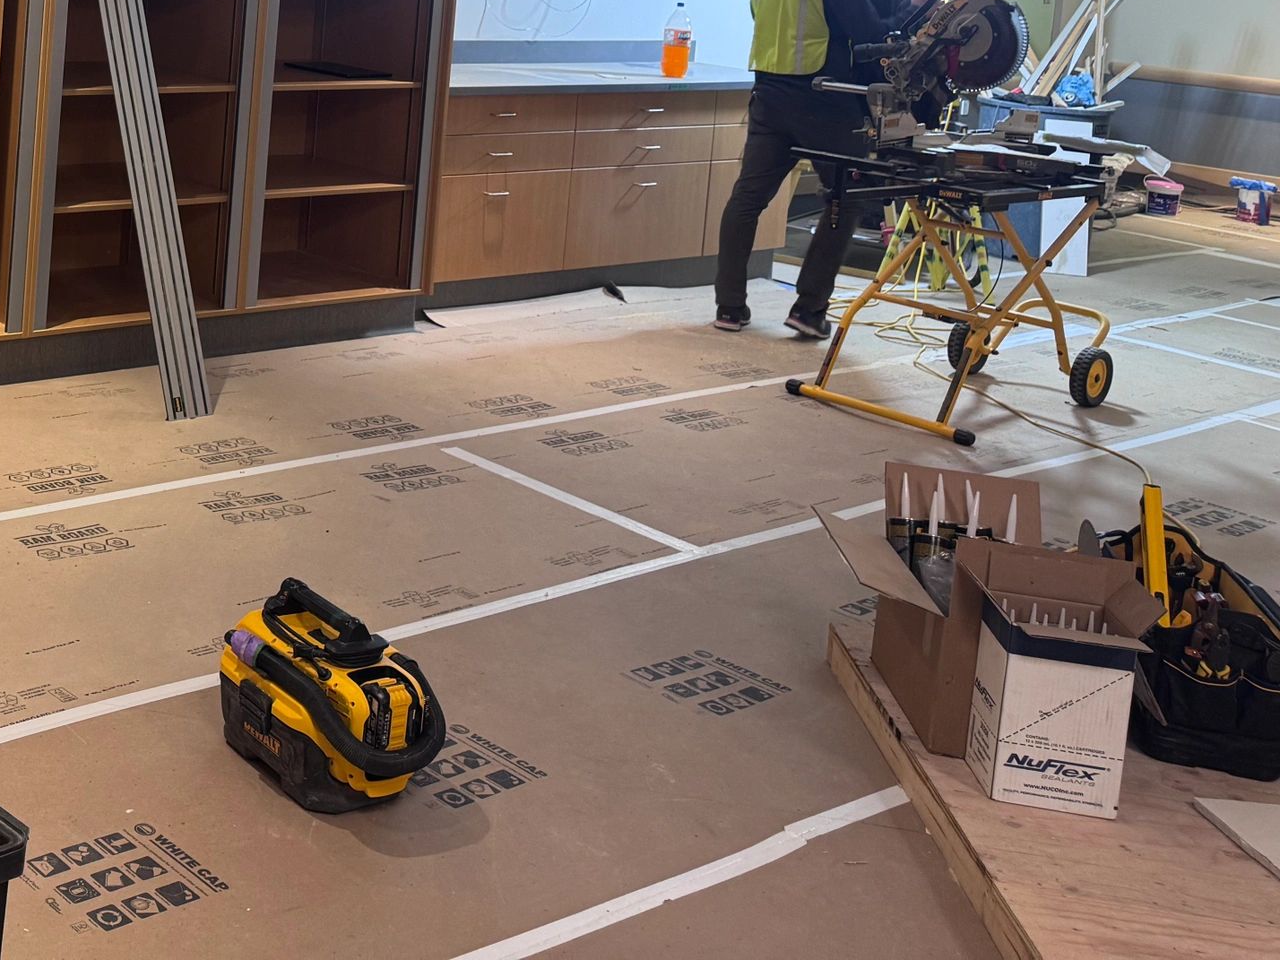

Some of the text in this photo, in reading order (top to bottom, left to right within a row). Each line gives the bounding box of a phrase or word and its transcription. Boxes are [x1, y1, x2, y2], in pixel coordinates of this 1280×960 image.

[26, 474, 108, 492] RAM BOARD
[203, 494, 284, 511] RAM BOARD
[20, 525, 109, 546] RAM BOARD
[466, 733, 549, 778] WHITE CAP
[1004, 753, 1103, 781] NuFlex
[1040, 773, 1096, 787] SEALANTS
[154, 834, 202, 870] WHITE
[197, 867, 230, 892] CAP
